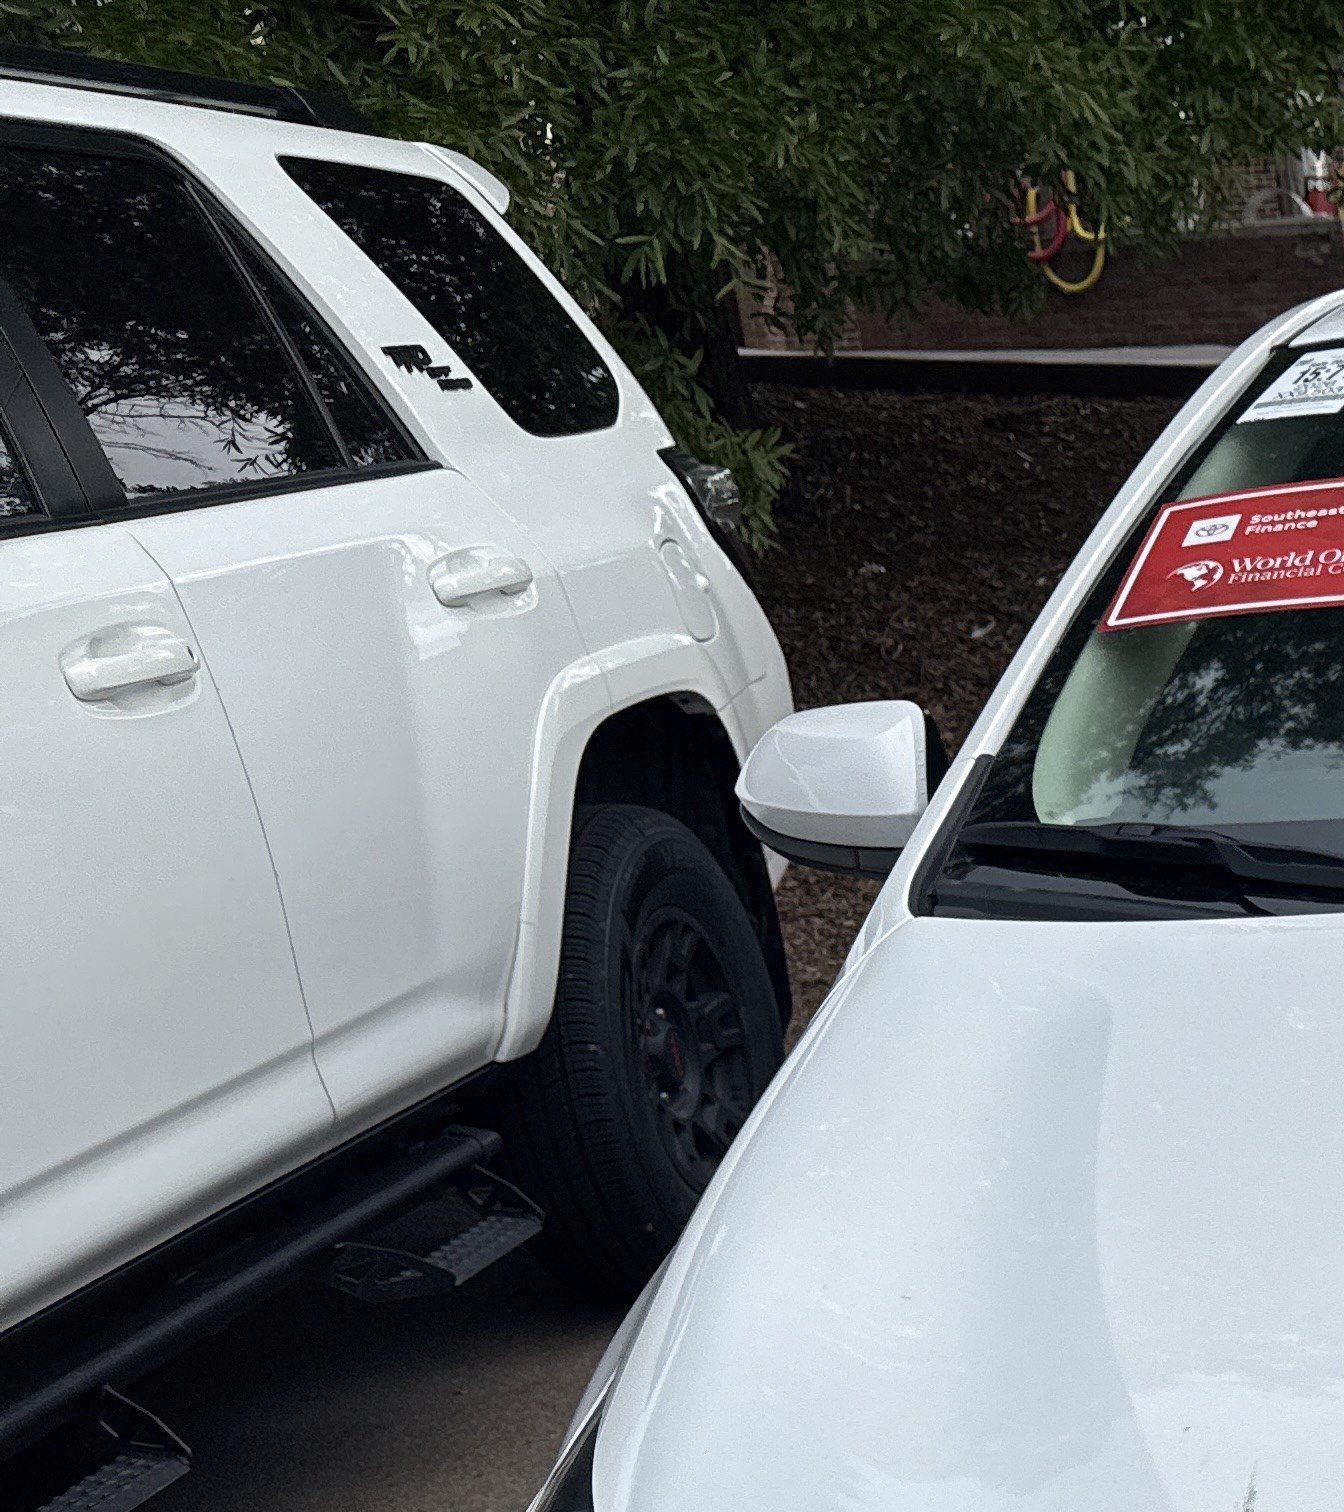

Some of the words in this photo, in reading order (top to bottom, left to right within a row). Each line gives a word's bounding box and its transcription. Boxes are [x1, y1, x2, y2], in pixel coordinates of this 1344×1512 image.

[1245, 520, 1318, 535] Finance
[1232, 550, 1314, 572] World
[1228, 564, 1323, 584] Financial
